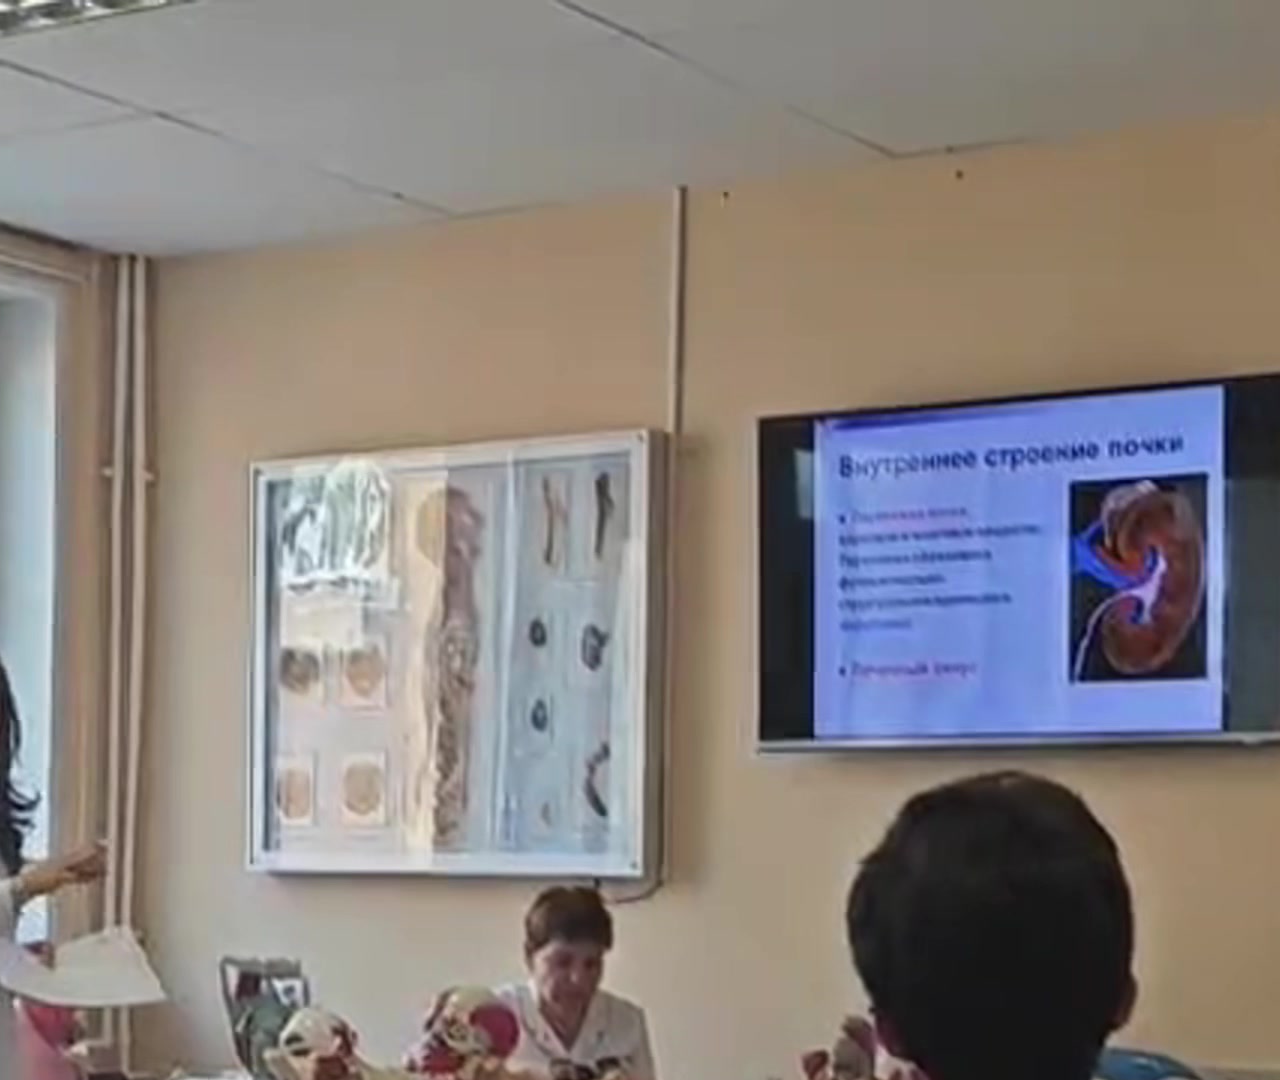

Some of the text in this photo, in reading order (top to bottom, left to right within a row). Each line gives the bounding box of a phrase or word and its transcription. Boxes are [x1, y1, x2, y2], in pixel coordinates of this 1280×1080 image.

[838, 435, 1185, 480] Внутреннее строение почки
